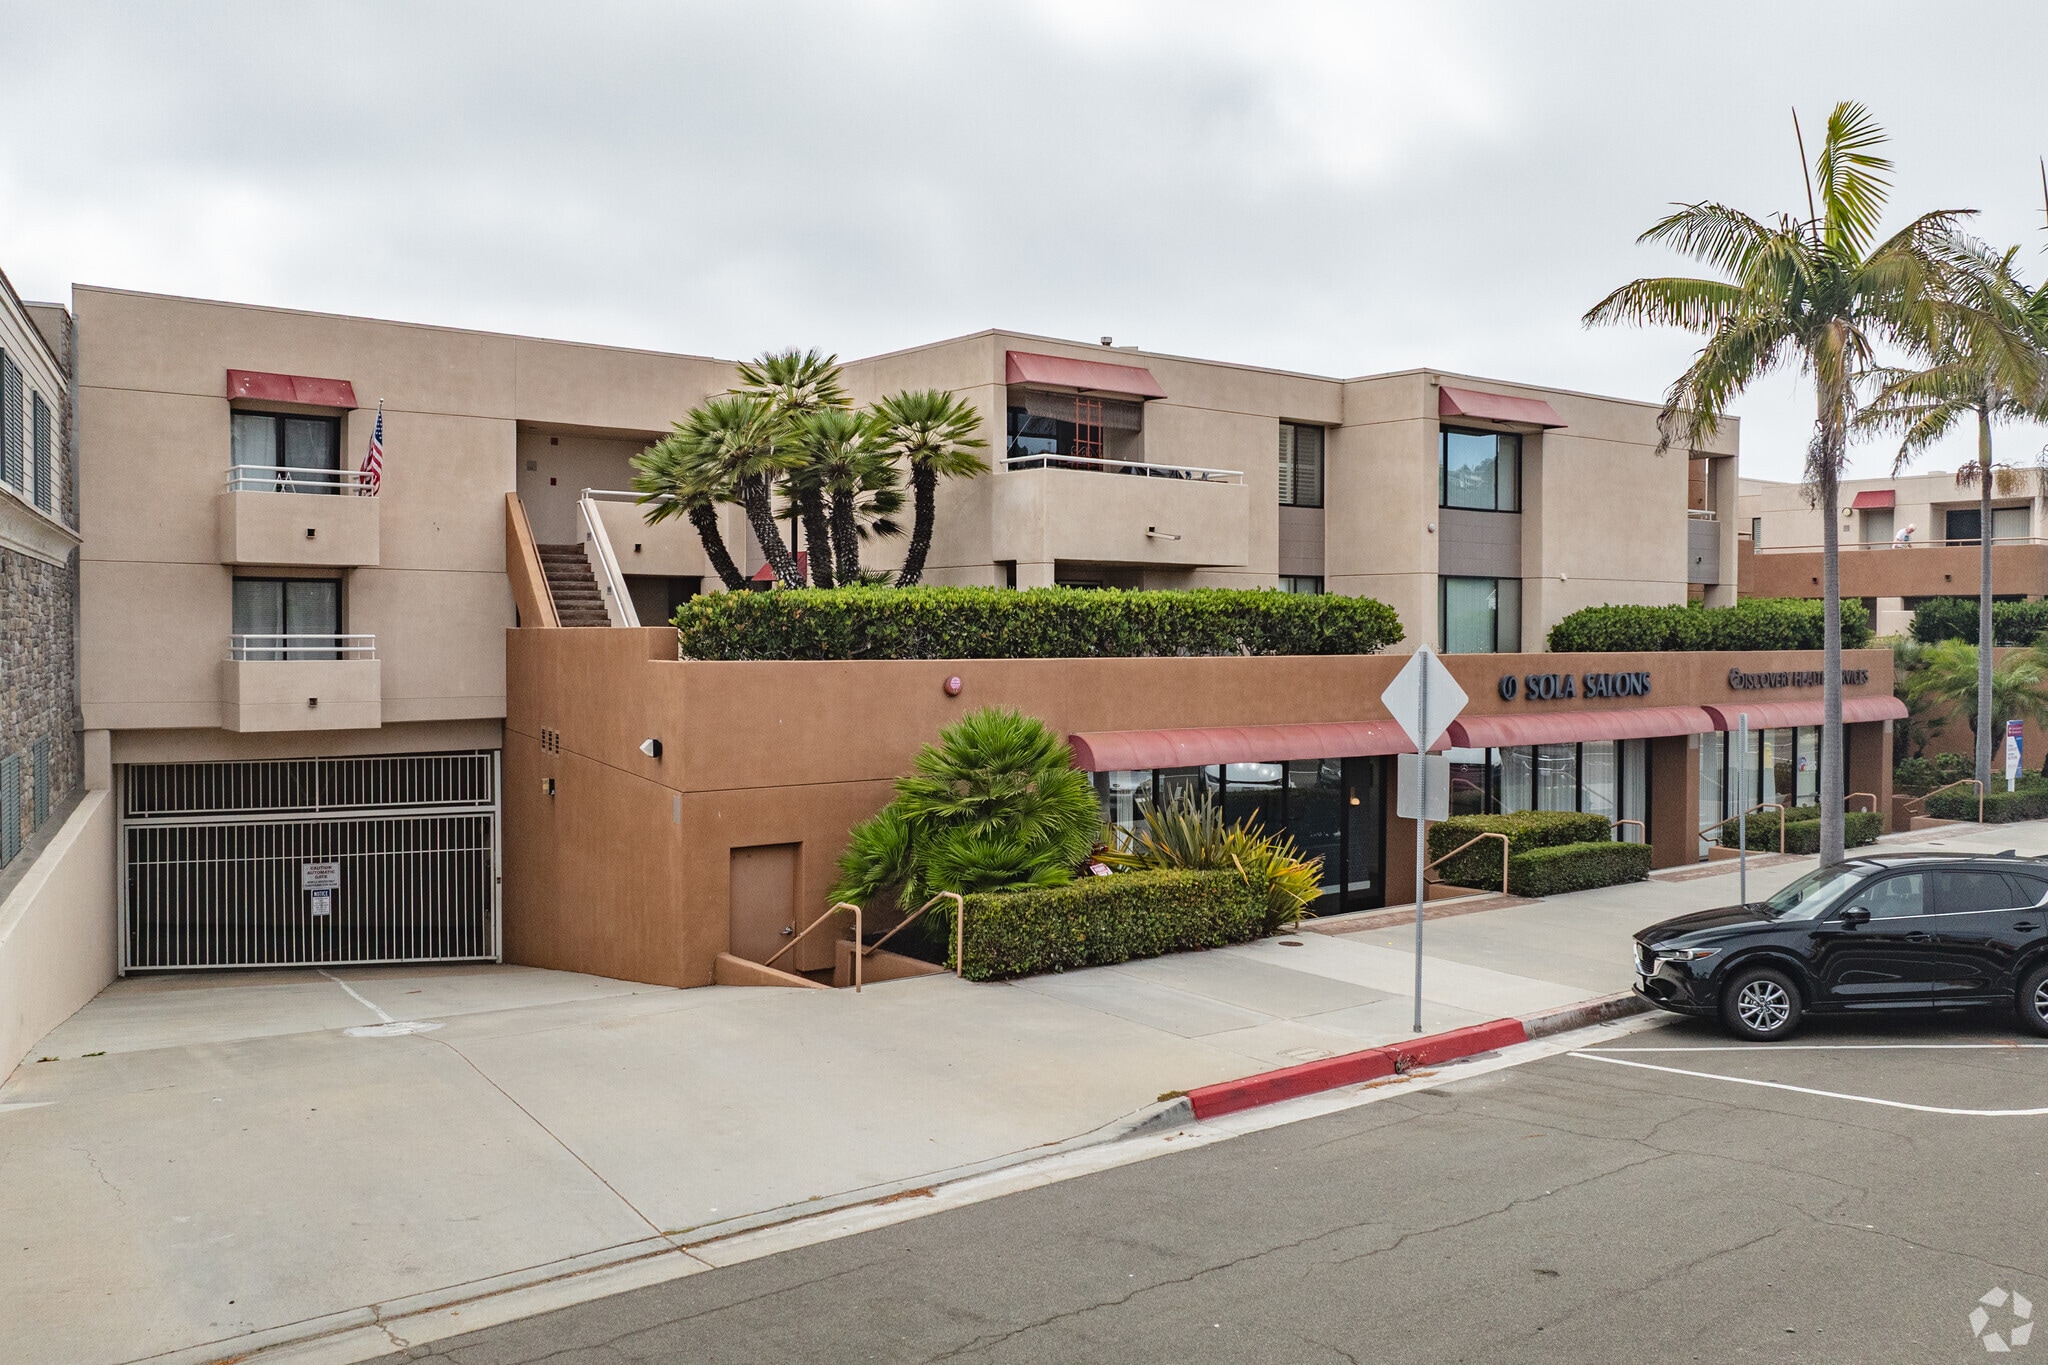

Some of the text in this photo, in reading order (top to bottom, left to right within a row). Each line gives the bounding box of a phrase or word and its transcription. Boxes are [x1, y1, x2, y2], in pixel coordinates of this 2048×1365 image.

[1525, 672, 1652, 700] SOLA SALONS
[1737, 669, 1869, 690] DISCOVERY HEALT RVICES
